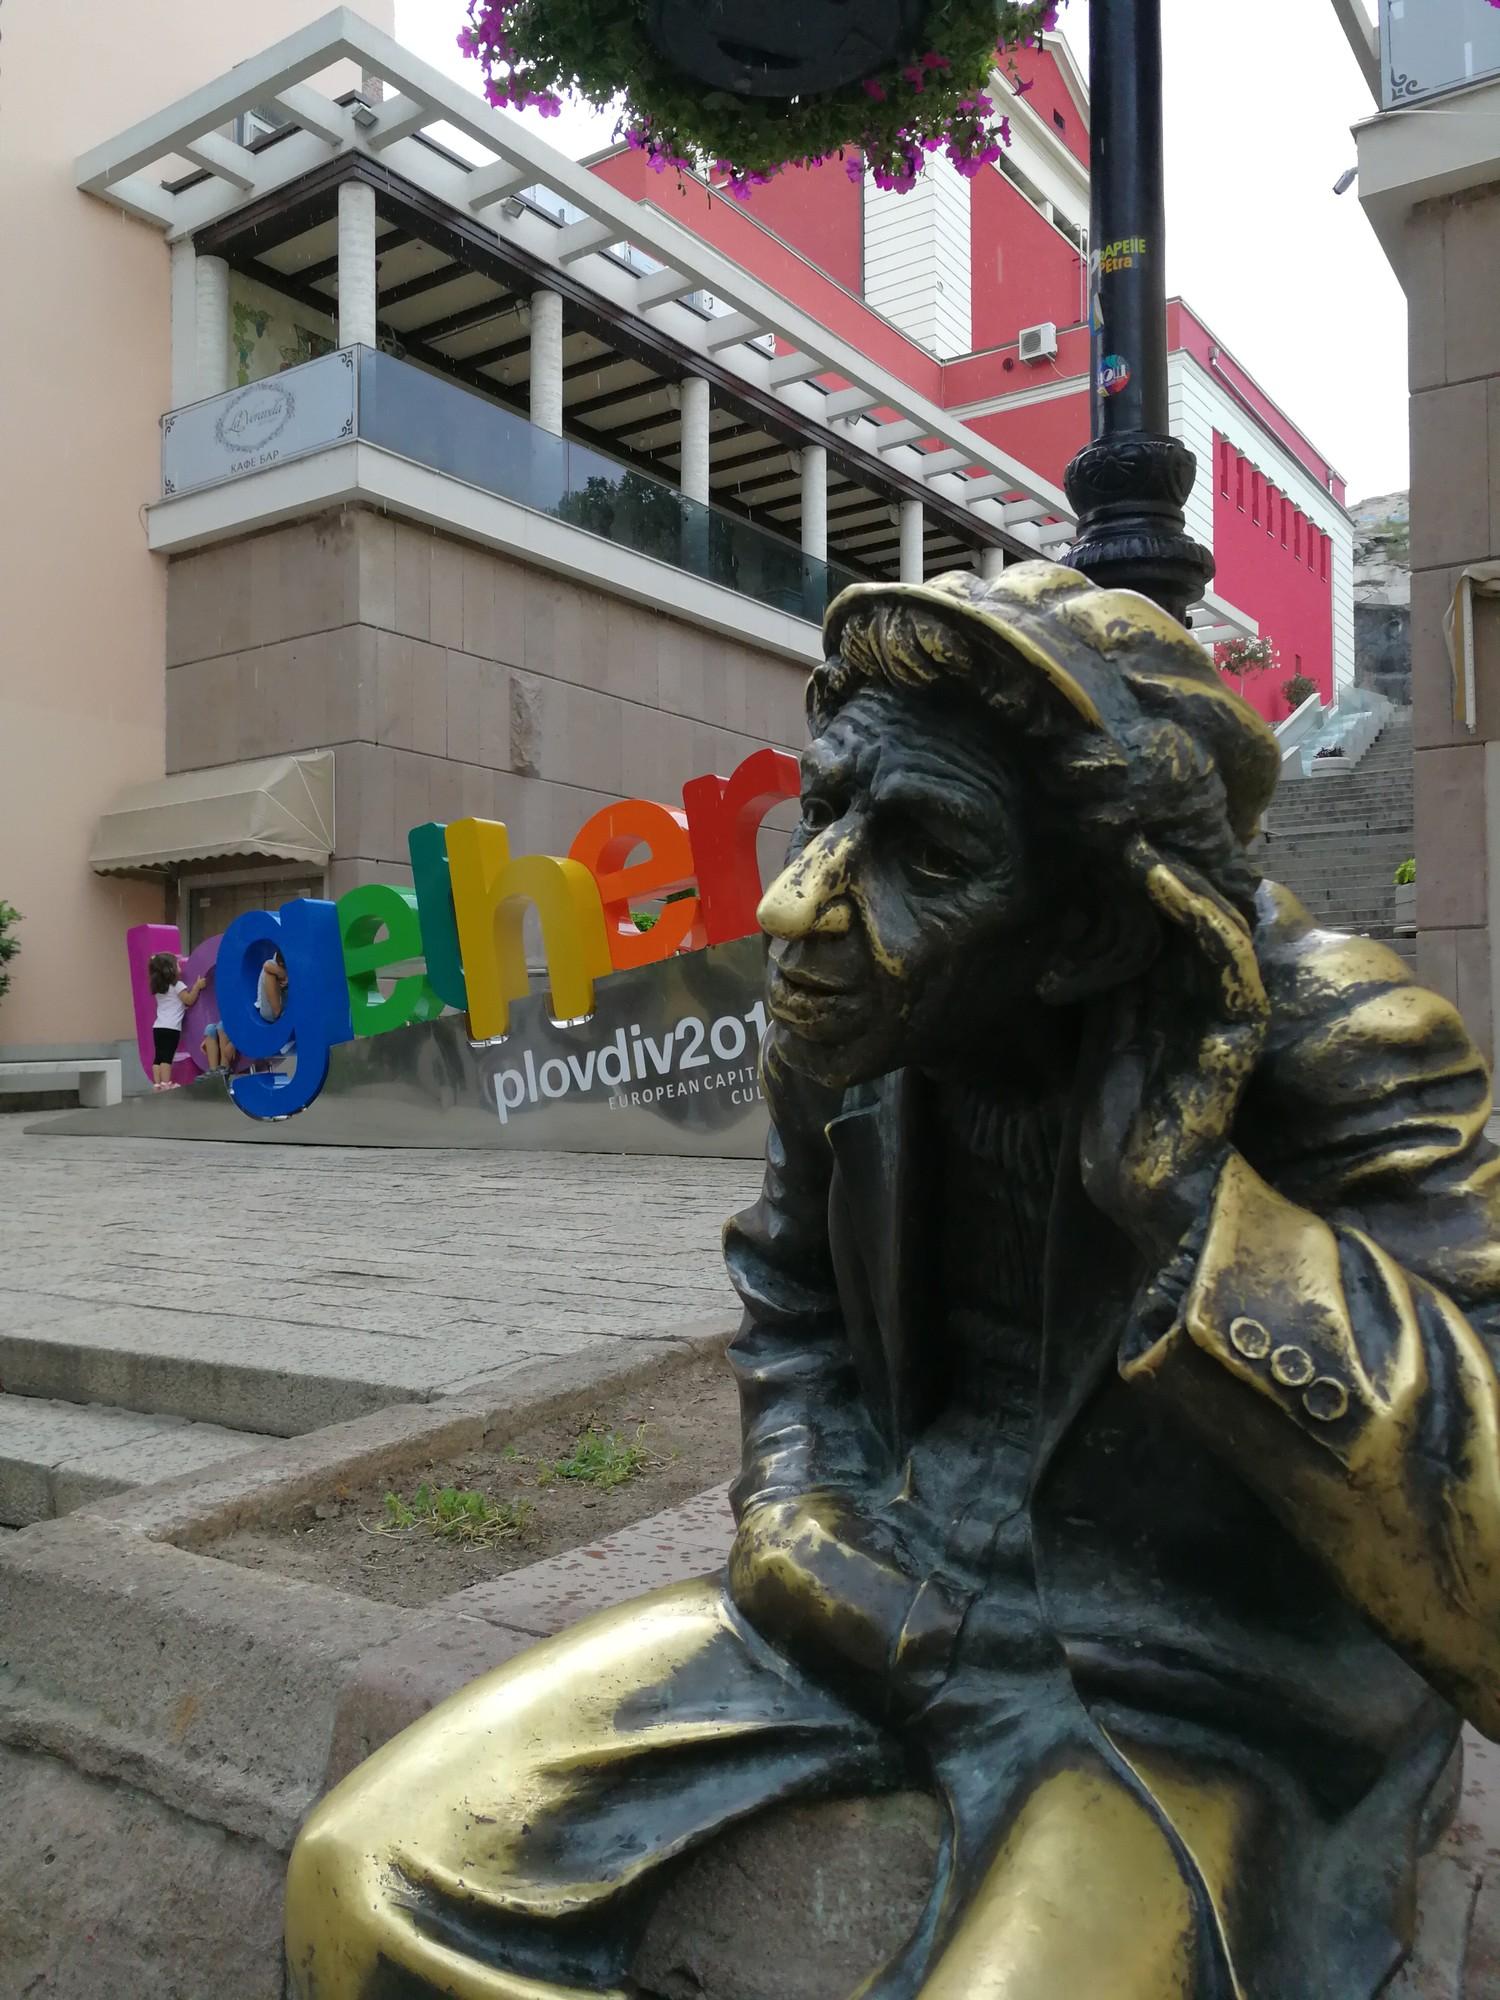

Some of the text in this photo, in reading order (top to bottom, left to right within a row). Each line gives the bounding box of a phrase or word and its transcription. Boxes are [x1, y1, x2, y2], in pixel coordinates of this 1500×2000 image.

[230, 449, 279, 474] КАФЕ БАР
[608, 1066, 761, 1110] EUROPEAN CAPIT
